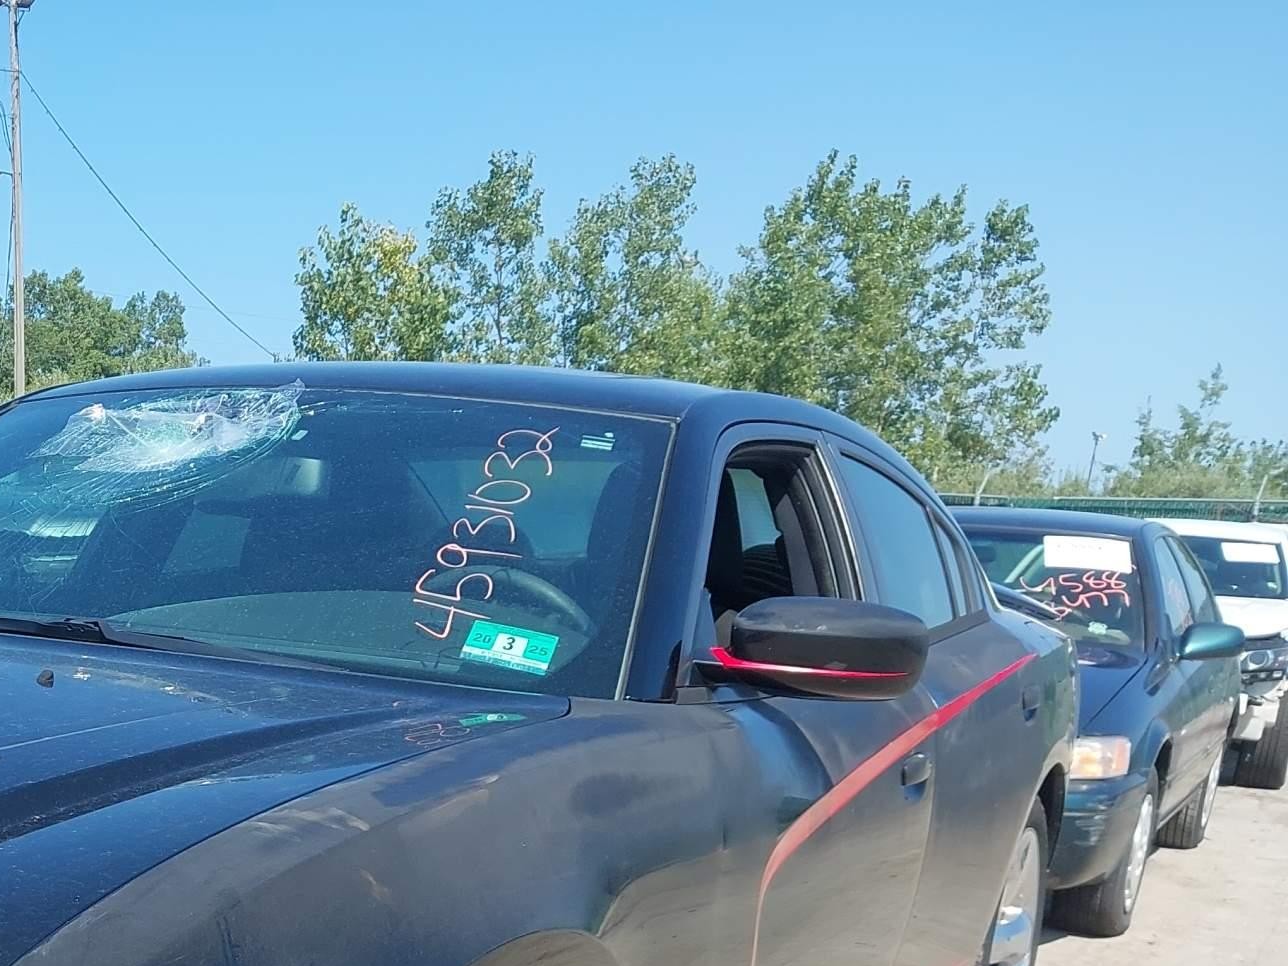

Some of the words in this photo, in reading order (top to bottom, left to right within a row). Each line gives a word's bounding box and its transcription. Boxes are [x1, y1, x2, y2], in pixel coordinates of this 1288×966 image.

[413, 426, 560, 638] 45931032
[503, 636, 516, 651] 3
[527, 645, 548, 657] 25
